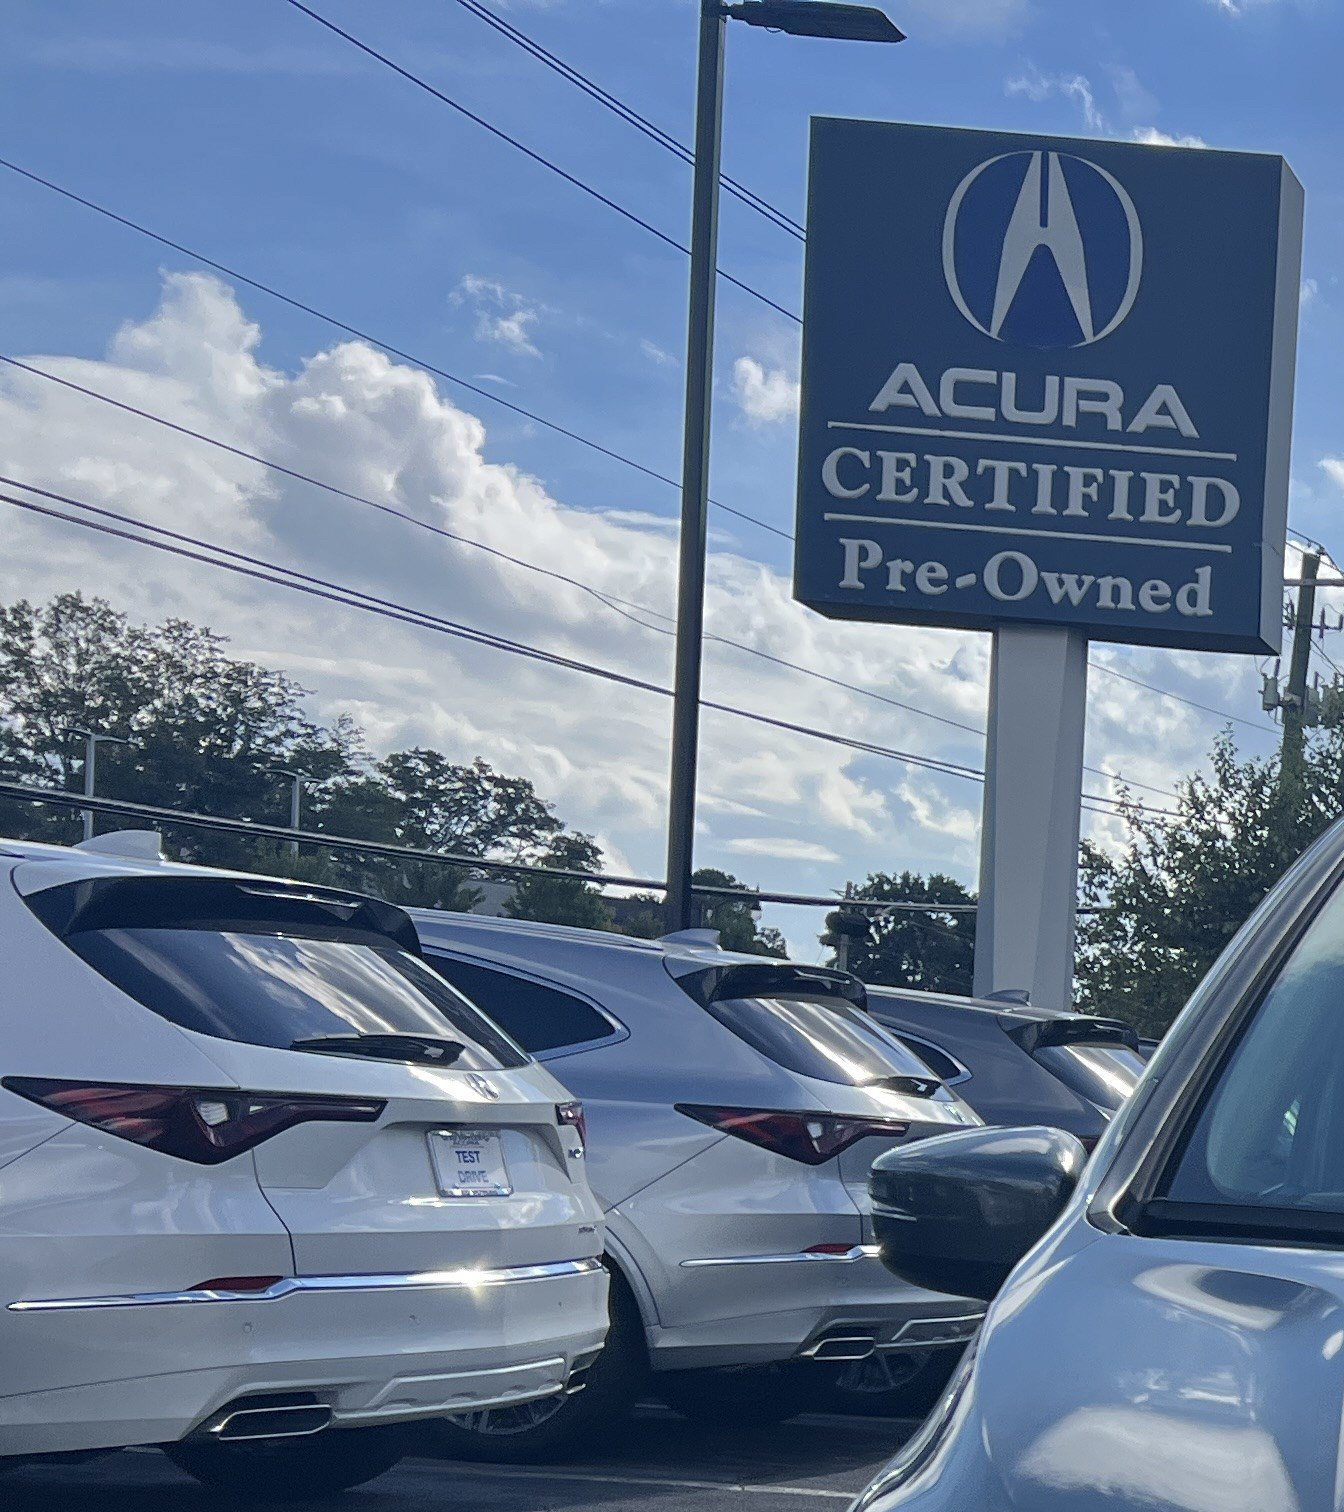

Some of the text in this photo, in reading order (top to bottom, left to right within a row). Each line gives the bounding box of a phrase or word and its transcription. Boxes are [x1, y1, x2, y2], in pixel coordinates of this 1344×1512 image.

[868, 362, 1200, 439] ACURA
[821, 446, 1242, 528] CERTIFIED
[837, 536, 1214, 617] Pre-Owned
[455, 1150, 481, 1164] TEST
[457, 1170, 490, 1184] DRIVE
